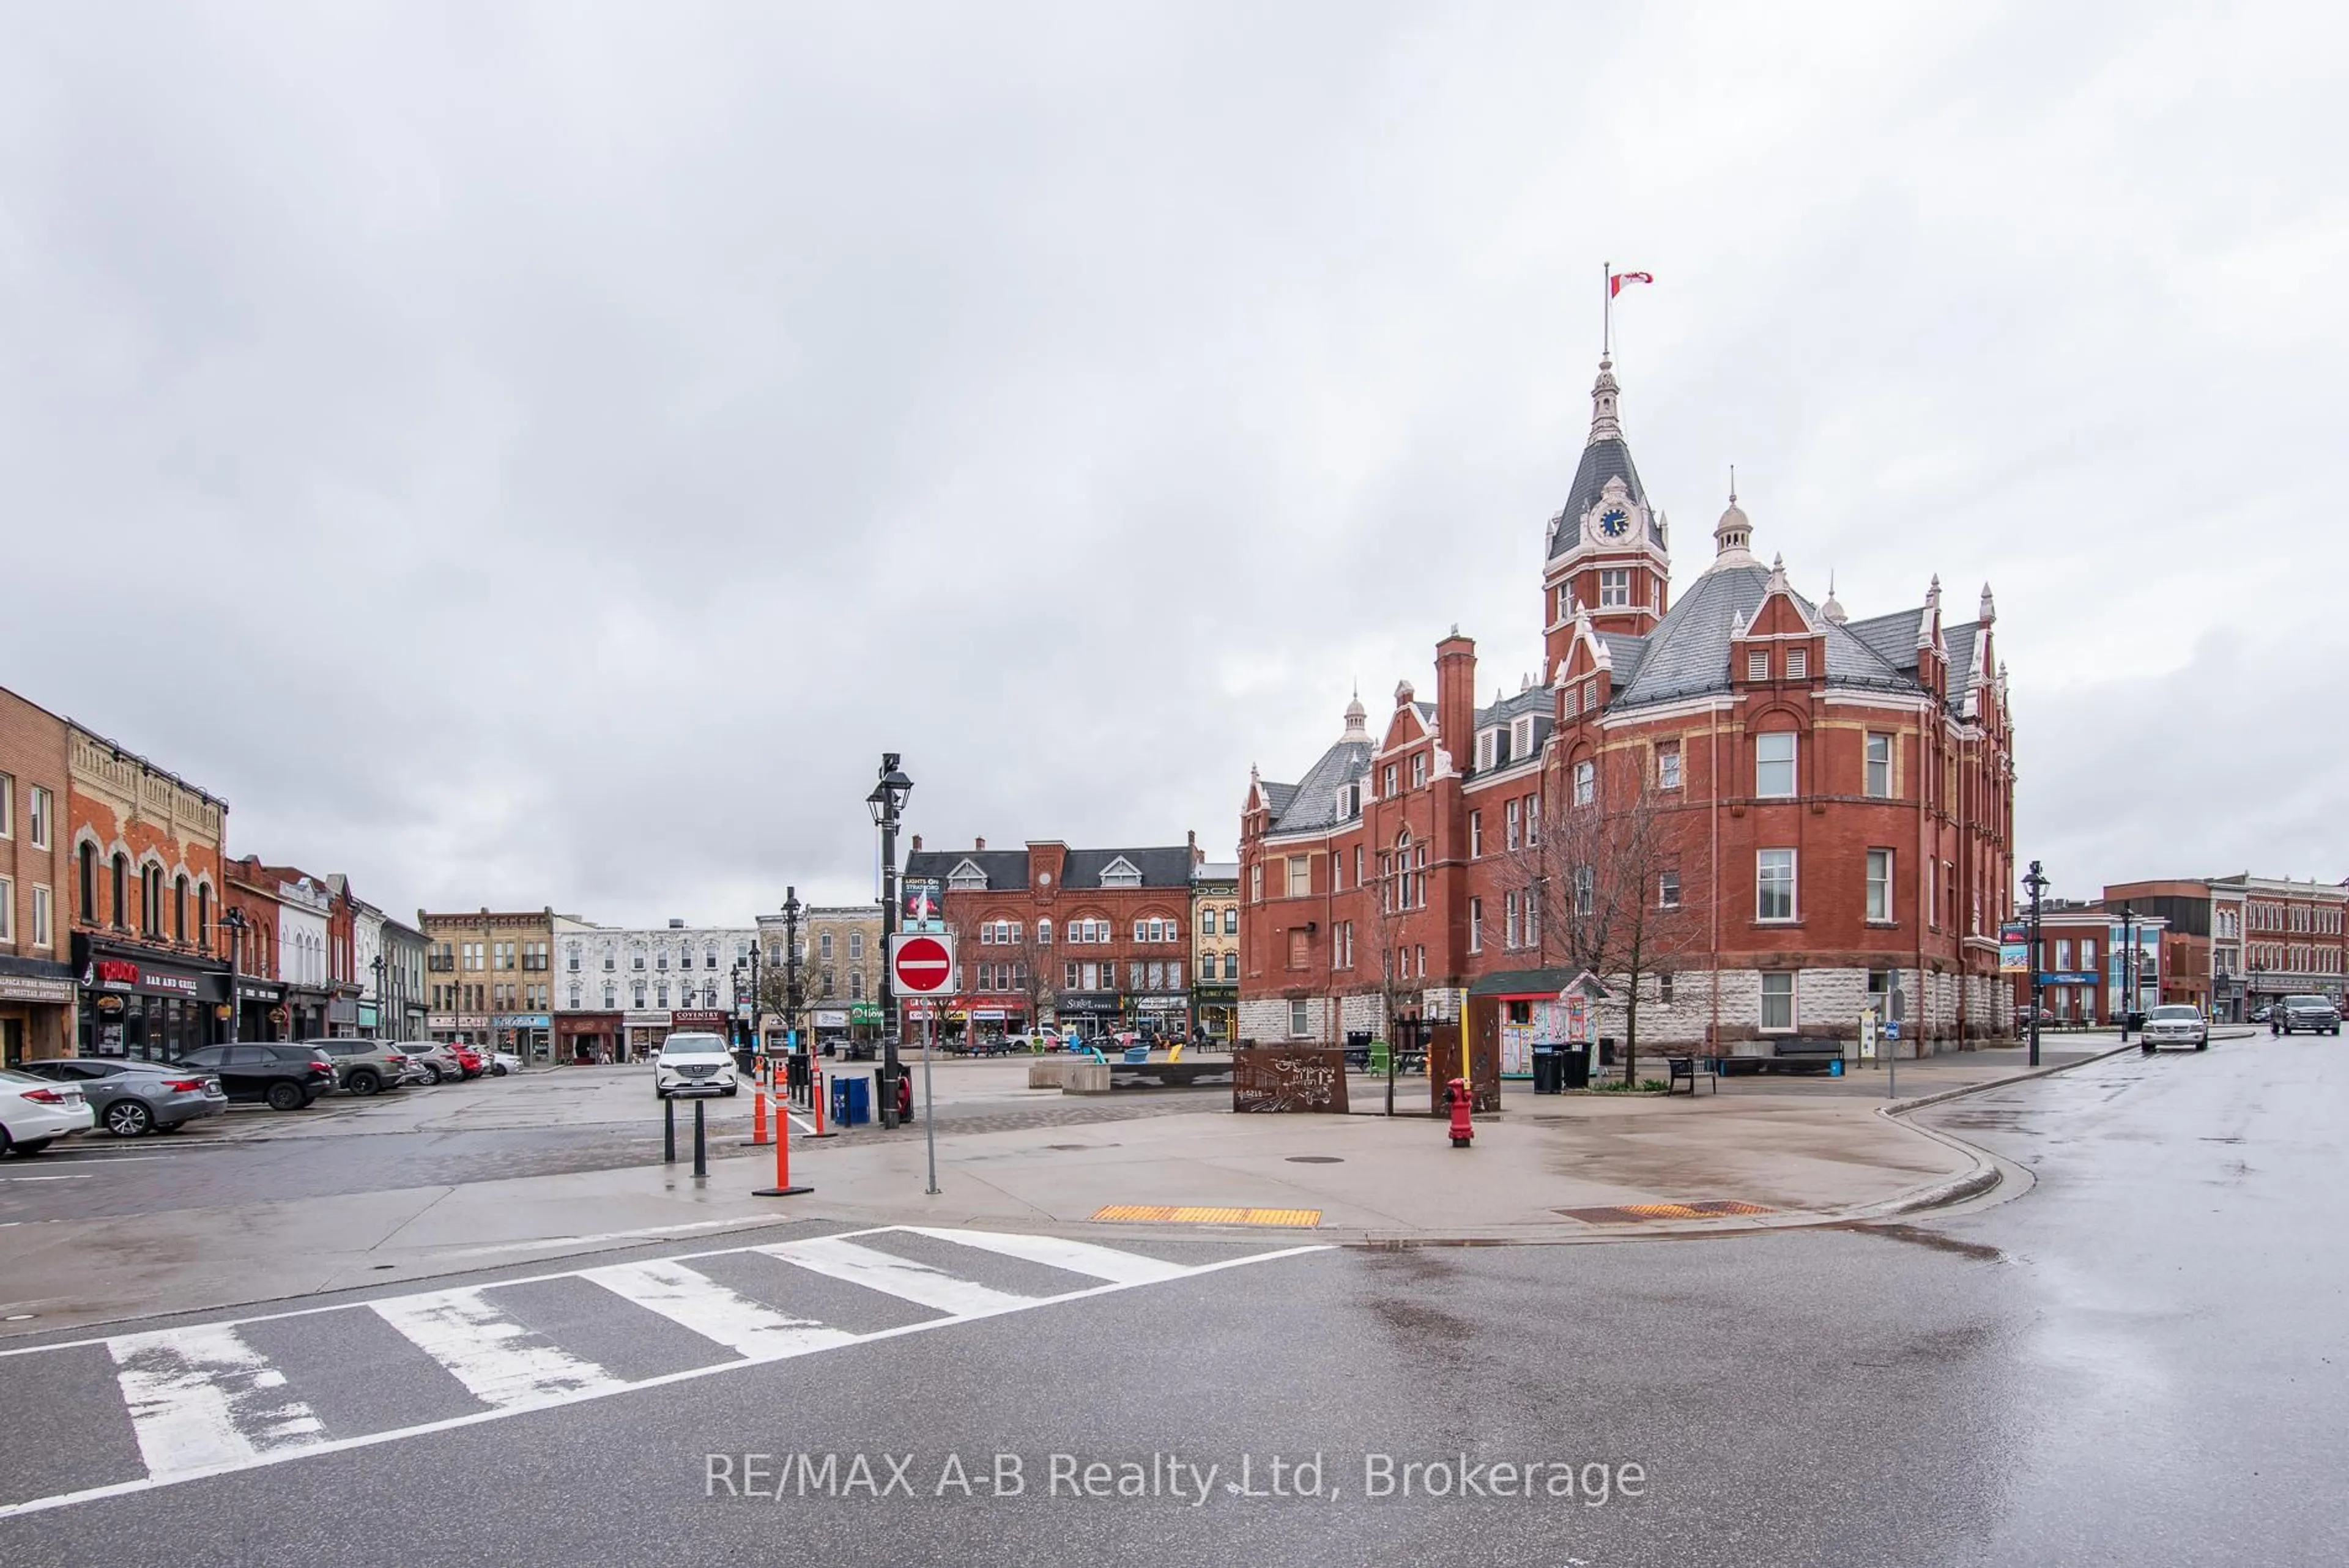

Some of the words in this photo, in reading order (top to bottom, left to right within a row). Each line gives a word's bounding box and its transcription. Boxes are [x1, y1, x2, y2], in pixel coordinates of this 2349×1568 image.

[146, 975, 160, 985] BAR
[163, 978, 177, 988] AND
[179, 980, 197, 989] GRILL
